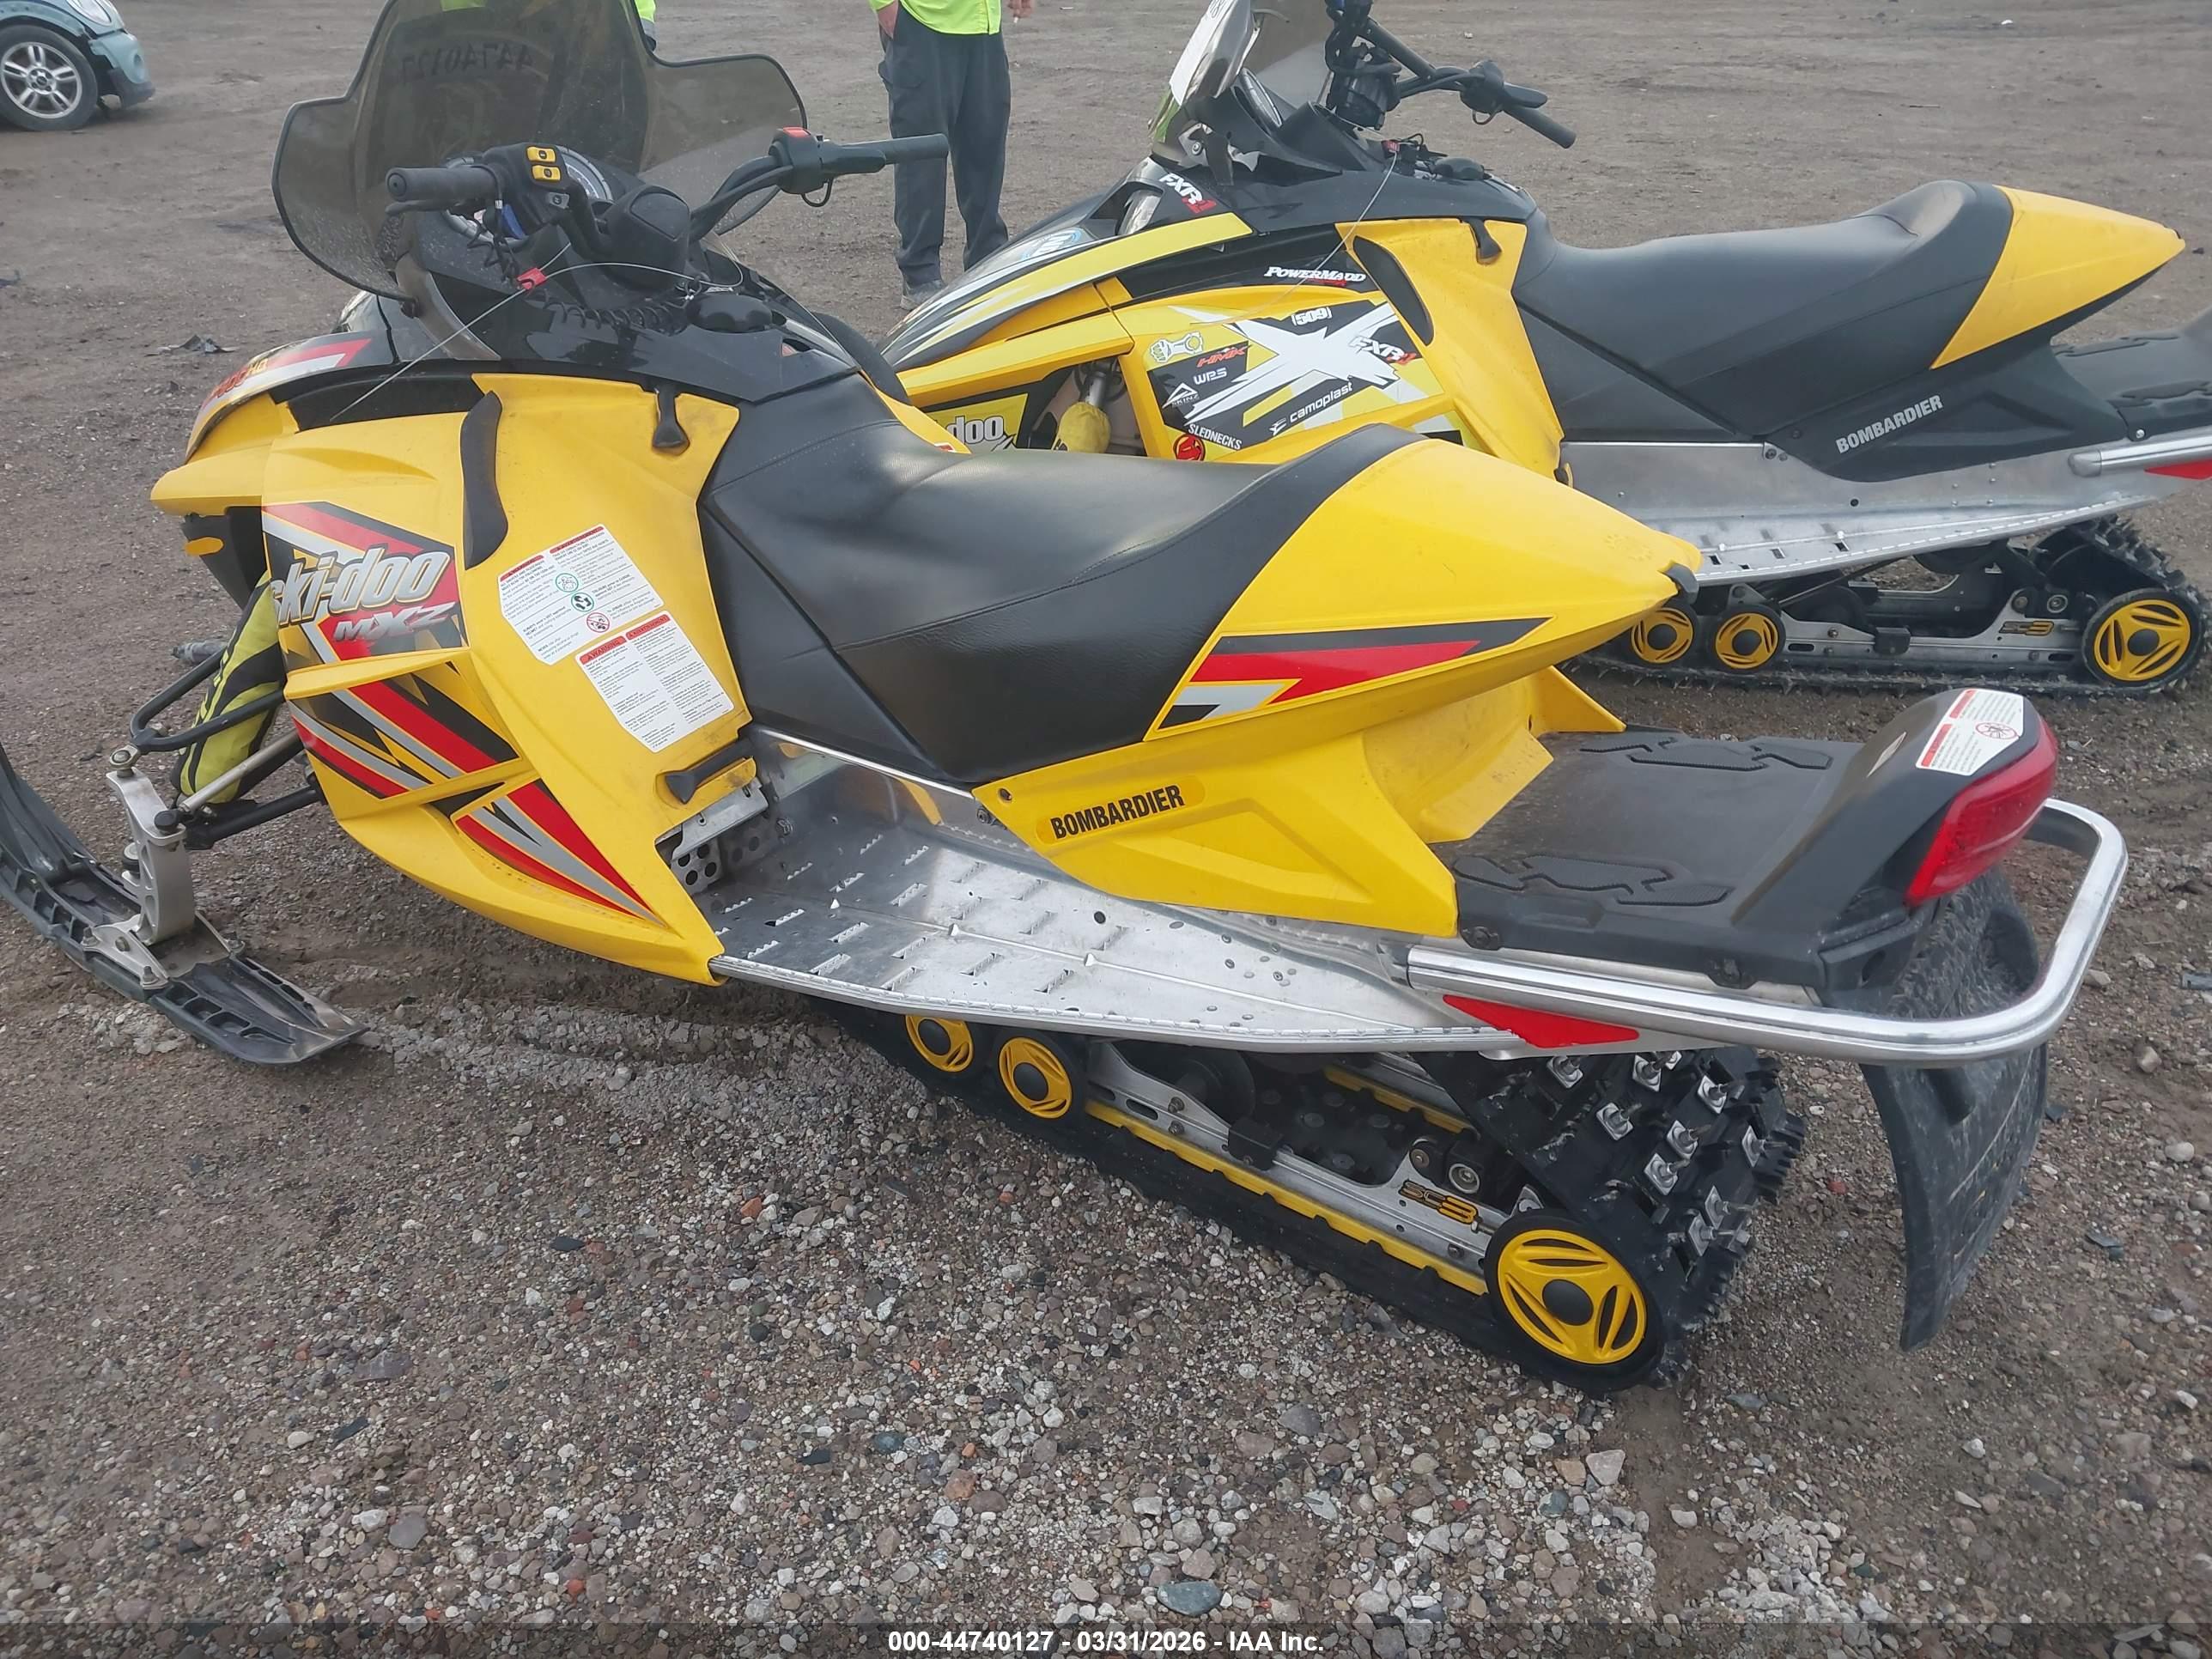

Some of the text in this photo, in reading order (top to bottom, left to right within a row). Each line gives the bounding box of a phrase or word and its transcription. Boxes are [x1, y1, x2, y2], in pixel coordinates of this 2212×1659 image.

[1194, 368, 1227, 385] WPS
[1290, 382, 1353, 423] camoplast
[1188, 423, 1243, 451] SLEDNECKS
[1836, 395, 1943, 453] BOMBARDIER
[1050, 785, 1186, 840] BOMBARDIER
